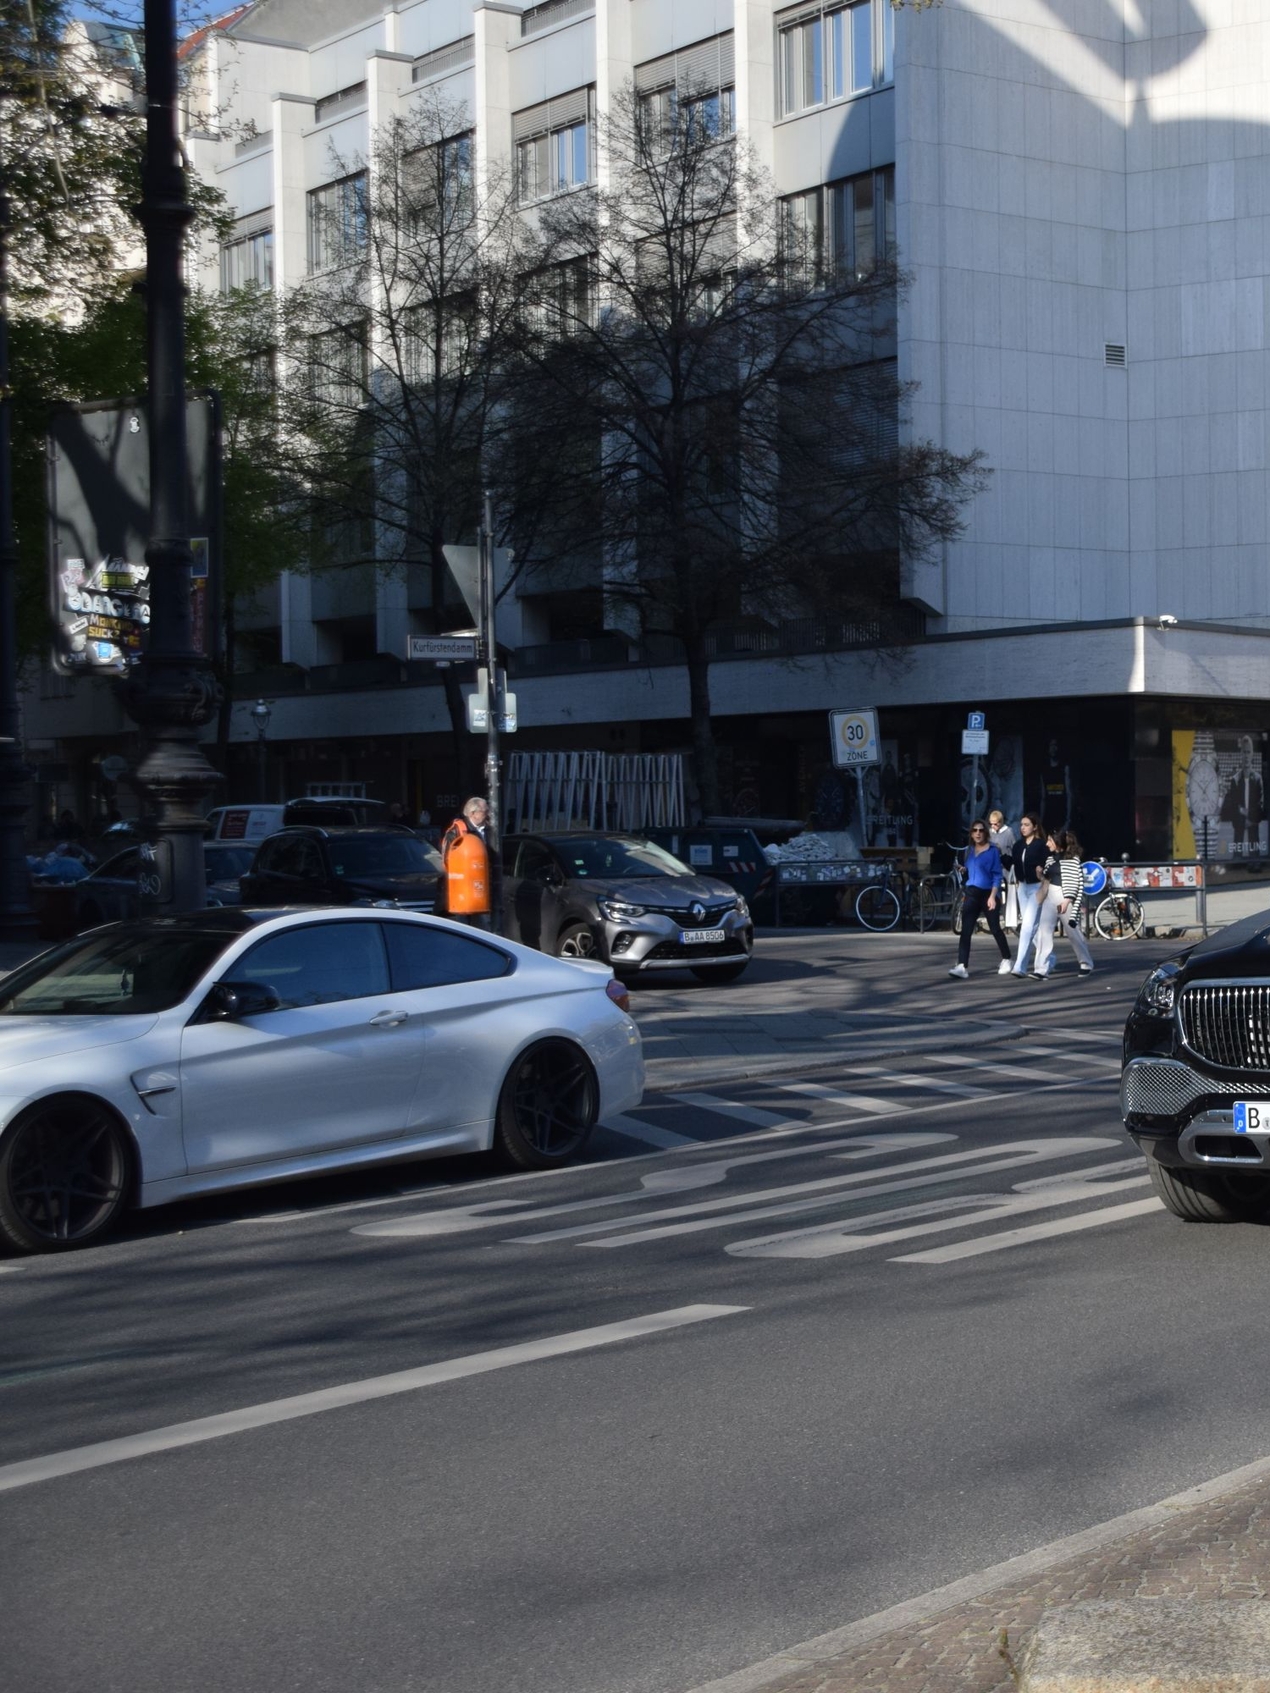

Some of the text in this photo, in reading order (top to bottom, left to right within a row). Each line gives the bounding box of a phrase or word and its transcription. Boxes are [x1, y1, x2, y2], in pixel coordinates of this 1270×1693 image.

[413, 641, 473, 653] Kurfürstendamm
[971, 715, 980, 728] P
[846, 724, 864, 741] 30
[846, 751, 868, 761] ZONE
[1228, 842, 1267, 852] BREITLING
[695, 932, 705, 941] AA
[706, 930, 724, 940] 8506
[1248, 1107, 1260, 1129] B
